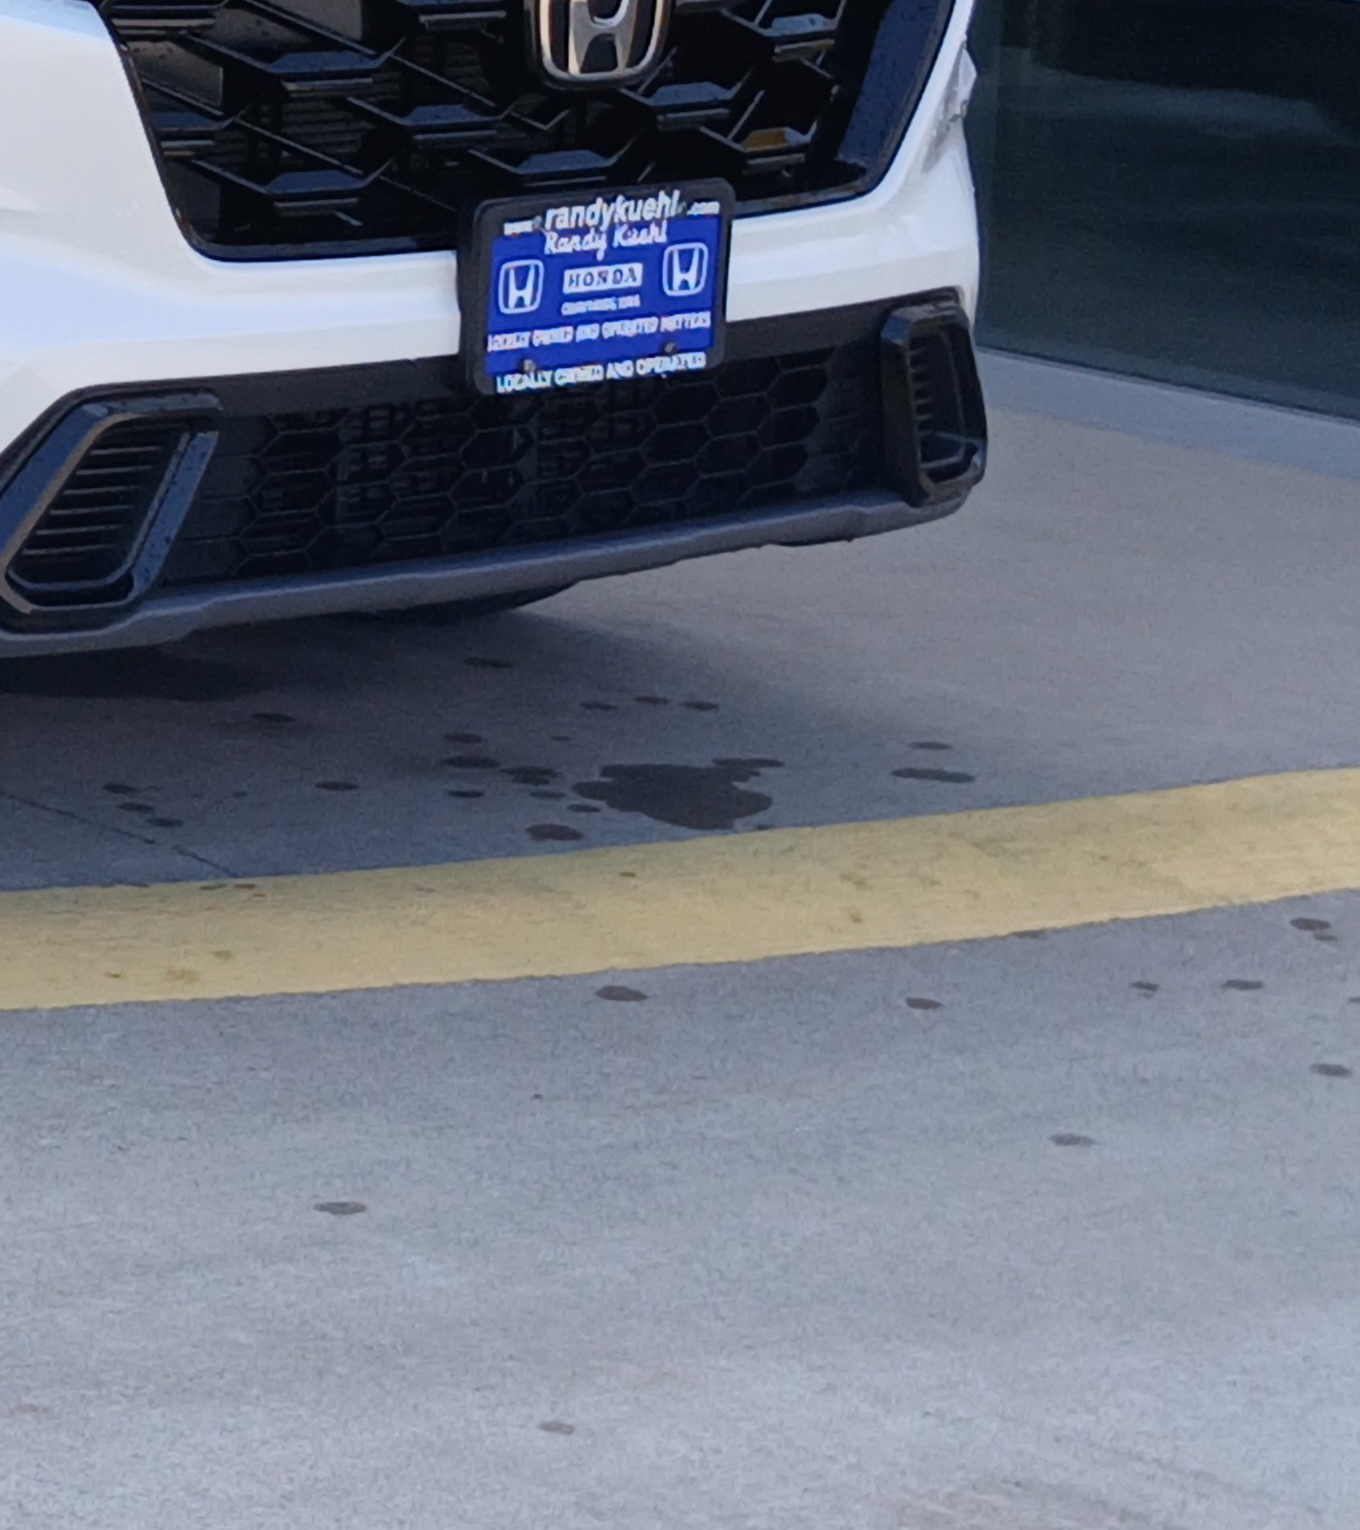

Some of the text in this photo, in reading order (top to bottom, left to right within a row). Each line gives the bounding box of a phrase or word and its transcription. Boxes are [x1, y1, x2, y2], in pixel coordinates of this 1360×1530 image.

[544, 221, 668, 261] Randy Kuehl
[568, 267, 637, 288] HONDA
